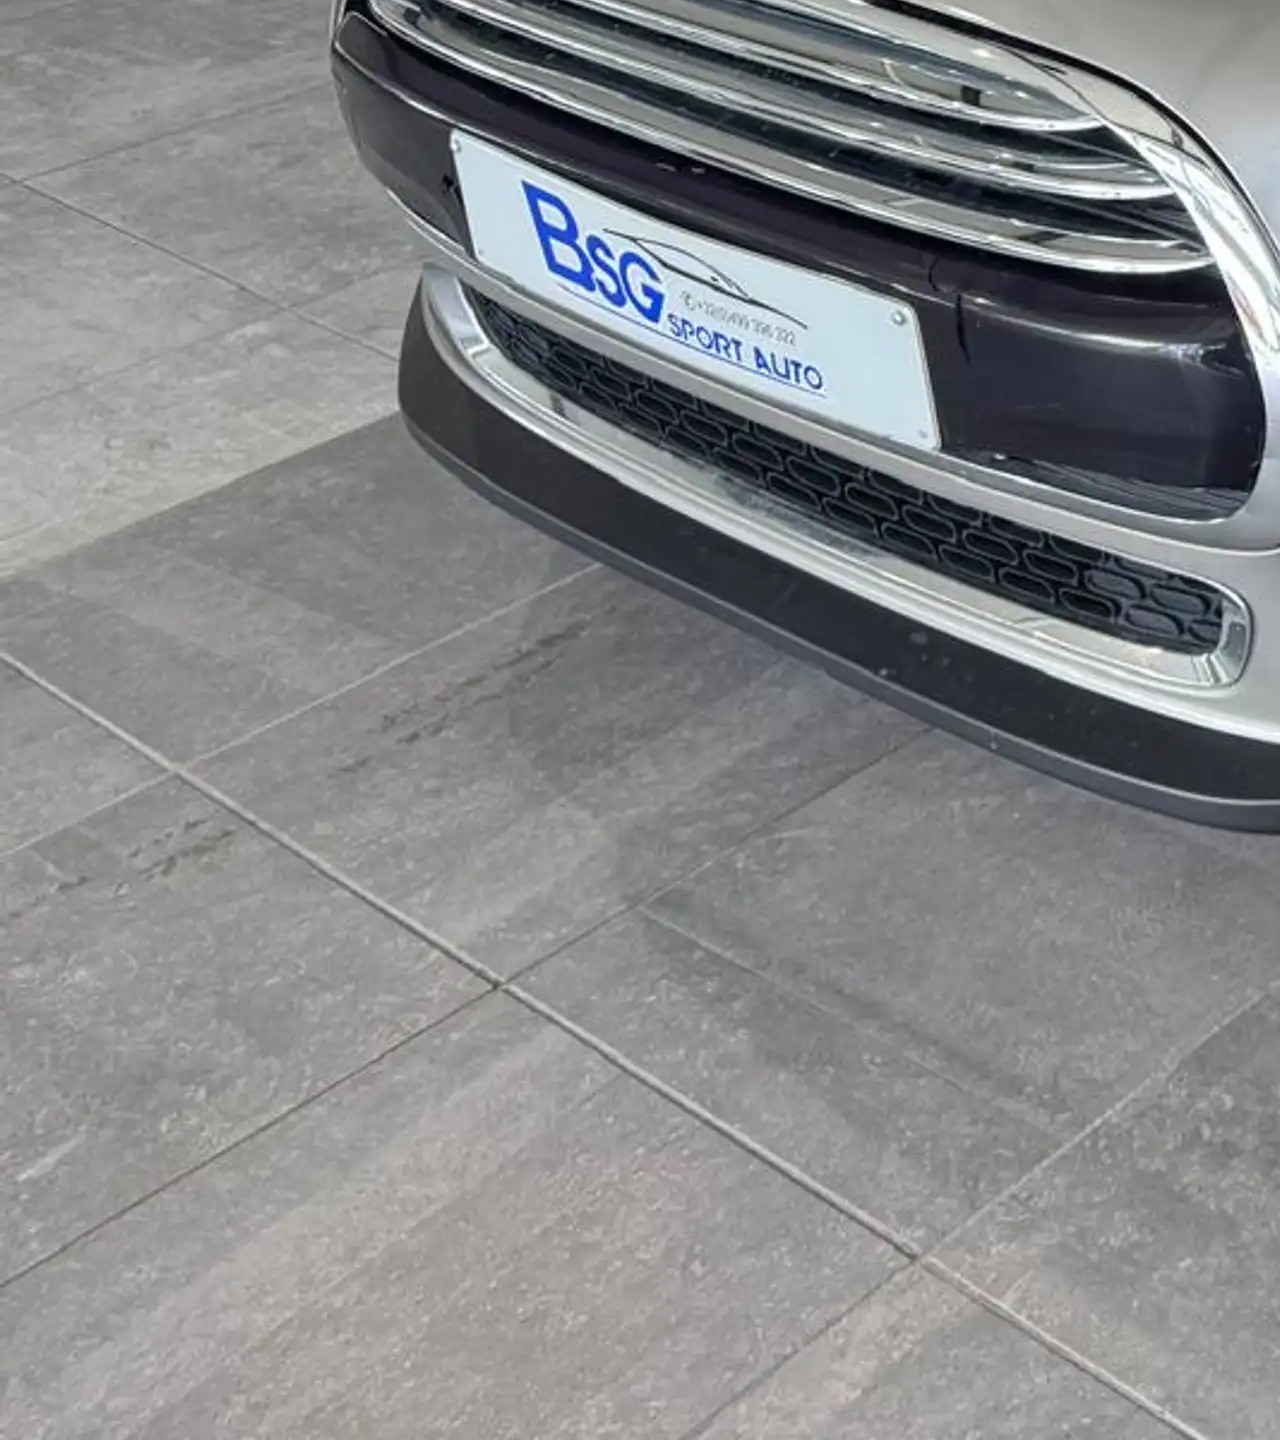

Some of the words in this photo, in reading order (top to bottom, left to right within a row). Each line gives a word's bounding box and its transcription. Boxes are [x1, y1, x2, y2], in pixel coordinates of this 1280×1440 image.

[521, 180, 665, 323] BSG
[667, 313, 743, 362] SPORT
[753, 345, 823, 390] AUTO
